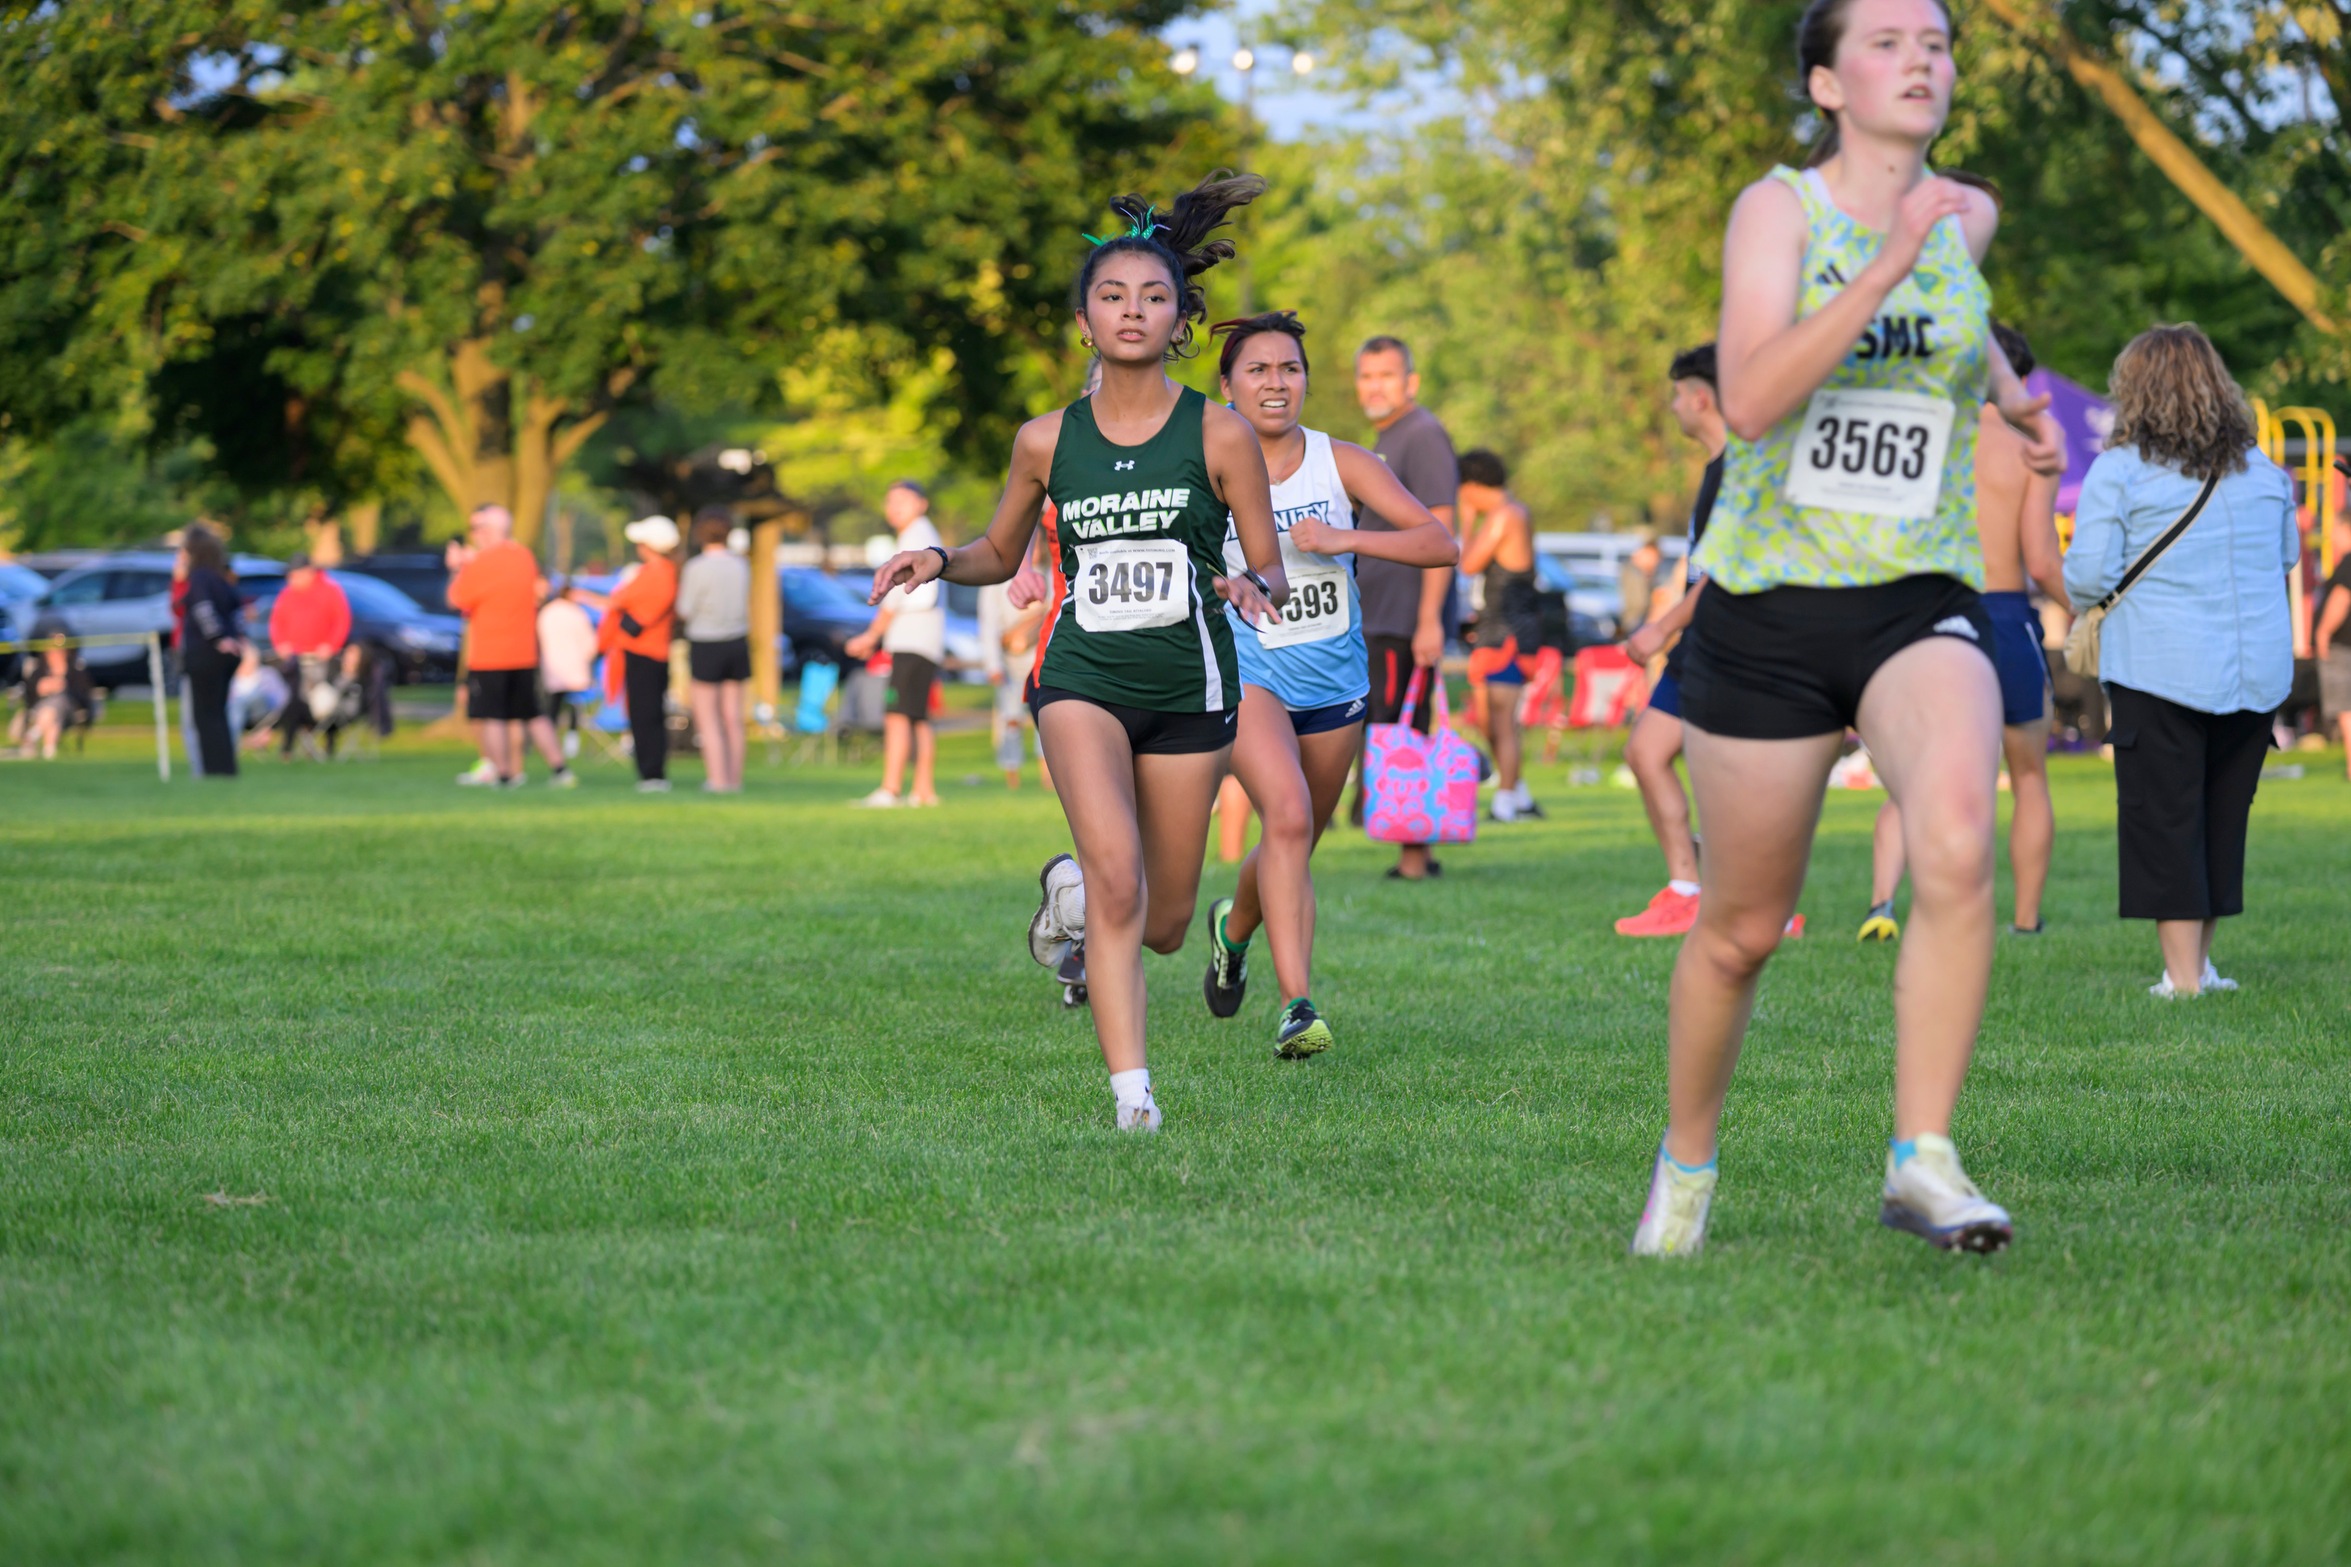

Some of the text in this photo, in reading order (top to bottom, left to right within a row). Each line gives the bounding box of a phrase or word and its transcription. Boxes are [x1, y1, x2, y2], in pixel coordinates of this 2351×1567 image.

[1810, 416, 1929, 480] 3563
[1062, 488, 1190, 522] MORAINE
[1072, 510, 1180, 539] VALLEY
[1088, 562, 1174, 605] 3497
[1267, 581, 1338, 625] 593
